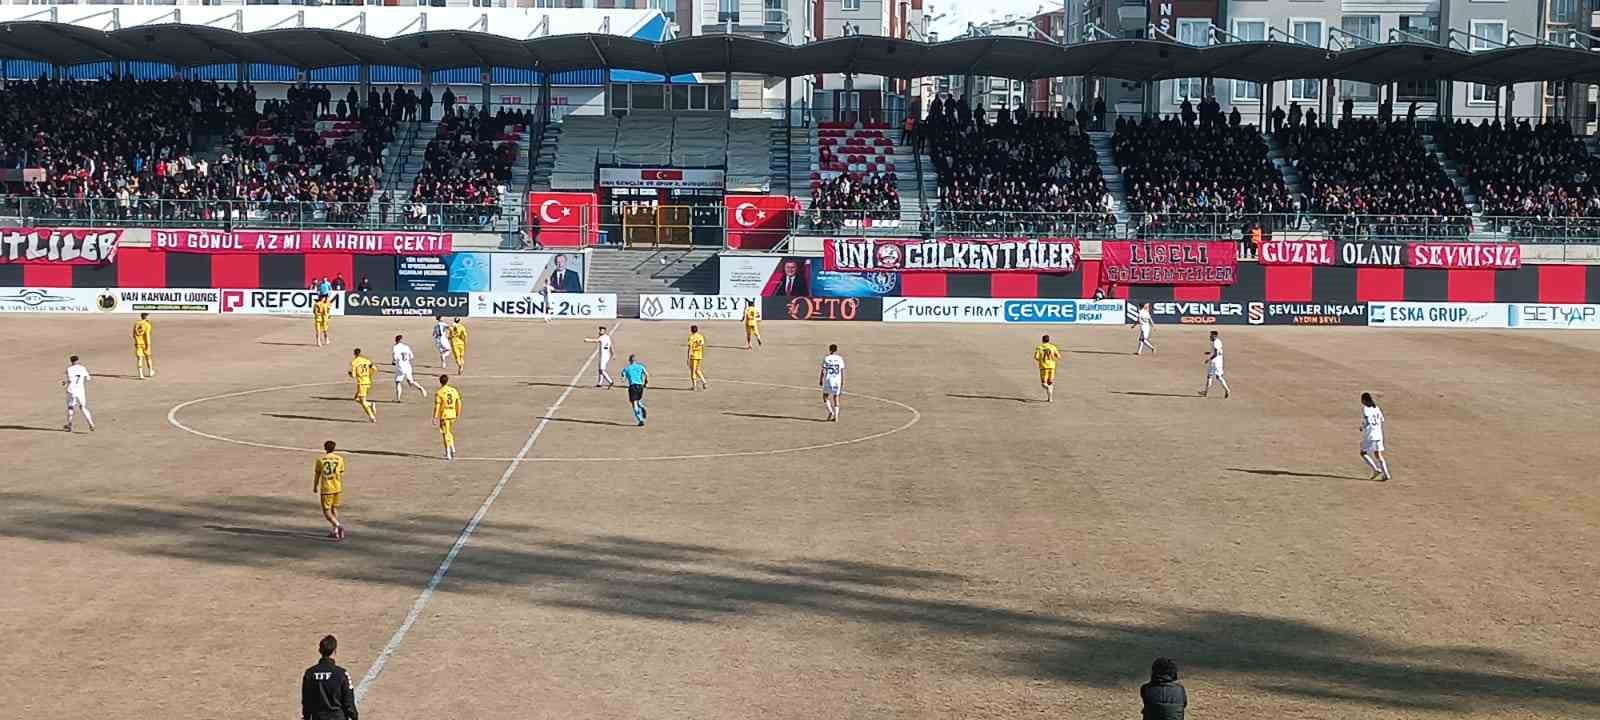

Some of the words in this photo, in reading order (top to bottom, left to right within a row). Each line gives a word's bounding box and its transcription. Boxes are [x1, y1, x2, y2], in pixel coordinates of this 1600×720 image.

[0, 231, 117, 261] TLİLER
[157, 232, 177, 247] BU
[312, 233, 383, 250] KAHRINI
[1342, 242, 1402, 265] OLANI
[121, 292, 139, 301] VAN
[184, 292, 218, 302] LOUNGE
[348, 293, 411, 307] CASABA
[415, 296, 468, 307] GROUP
[907, 304, 960, 317] TURGUT
[964, 305, 1000, 317] FIRAT
[1008, 303, 1074, 321] ÇEVRE
[1152, 302, 1243, 315] SEVENLER
[1390, 307, 1425, 320] ESKA
[1429, 308, 1468, 321] GRUP
[1523, 306, 1596, 325] SETYAP
[1180, 316, 1217, 324] GROUP
